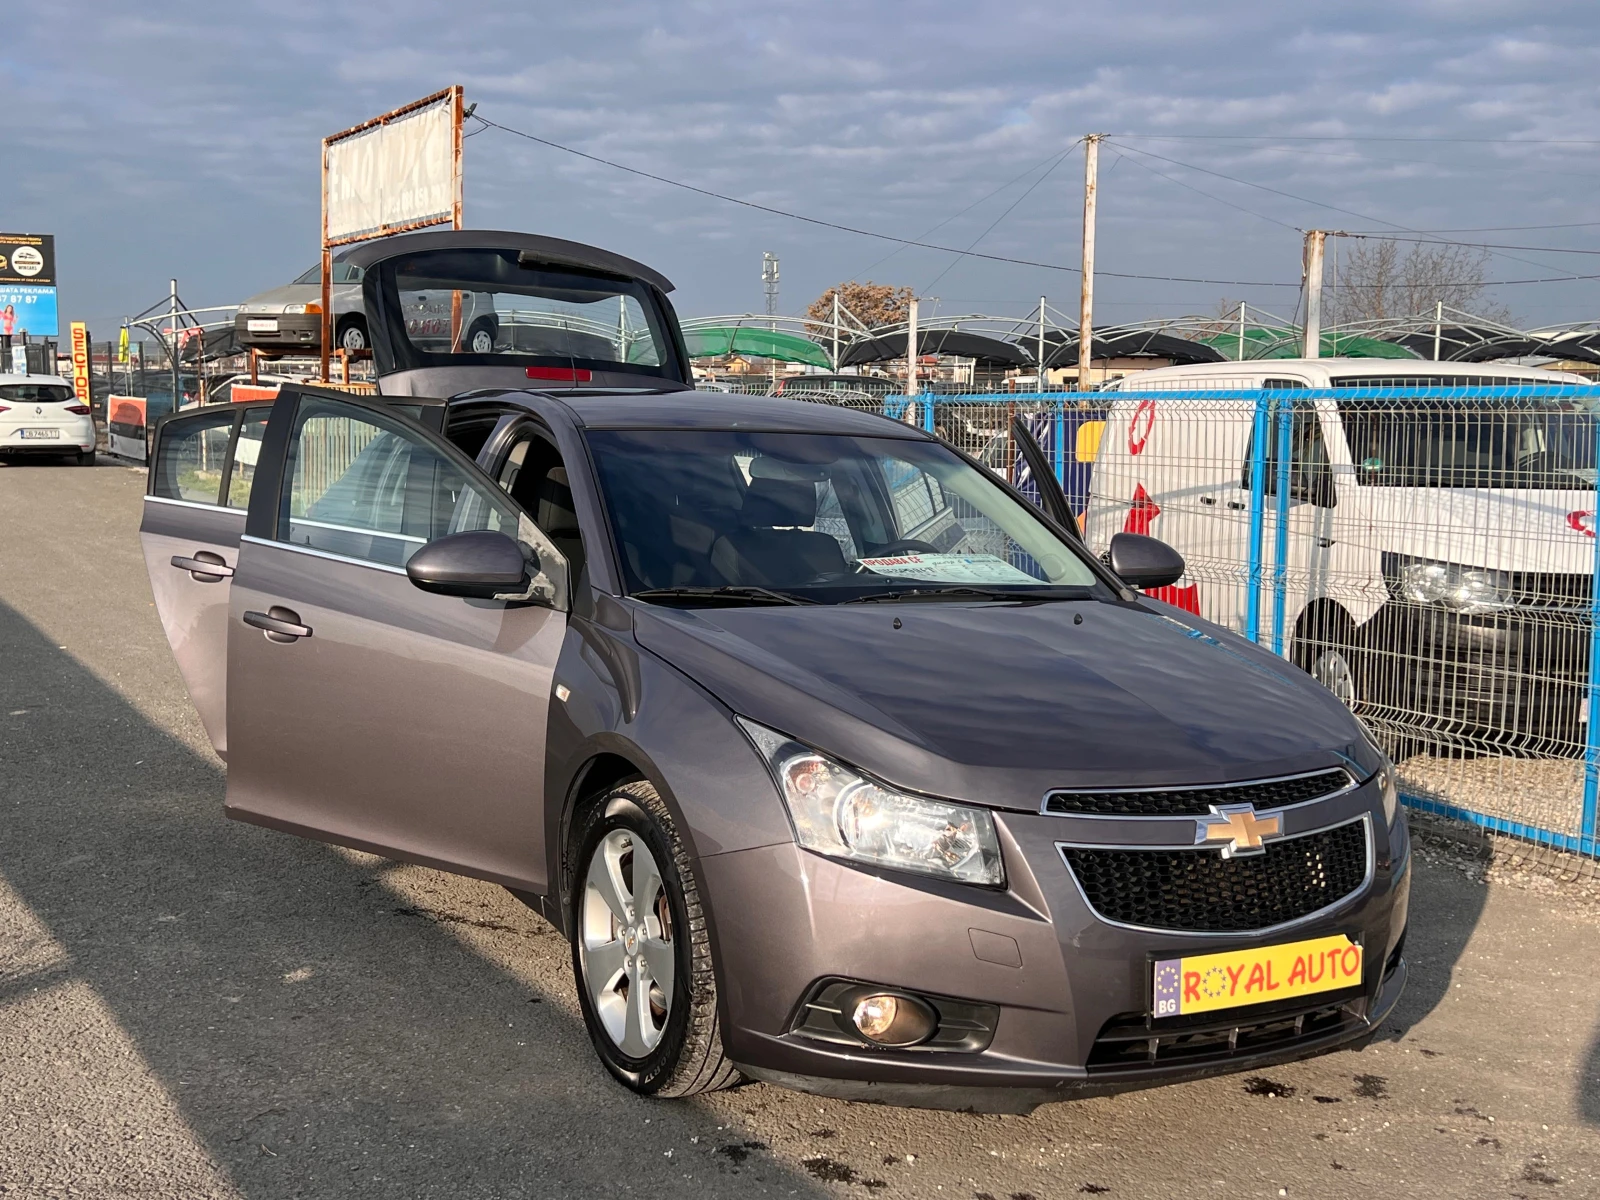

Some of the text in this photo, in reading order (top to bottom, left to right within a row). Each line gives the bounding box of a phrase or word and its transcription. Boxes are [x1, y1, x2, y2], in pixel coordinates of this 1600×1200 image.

[20, 287, 54, 295] РЕКЛАМА
[10, 294, 23, 304] 87
[25, 295, 38, 304] 87
[73, 328, 88, 399] SECTOR
[862, 557, 909, 566] ПРОДАВА
[1287, 945, 1360, 986] AUTO
[1158, 999, 1176, 1014] BG
